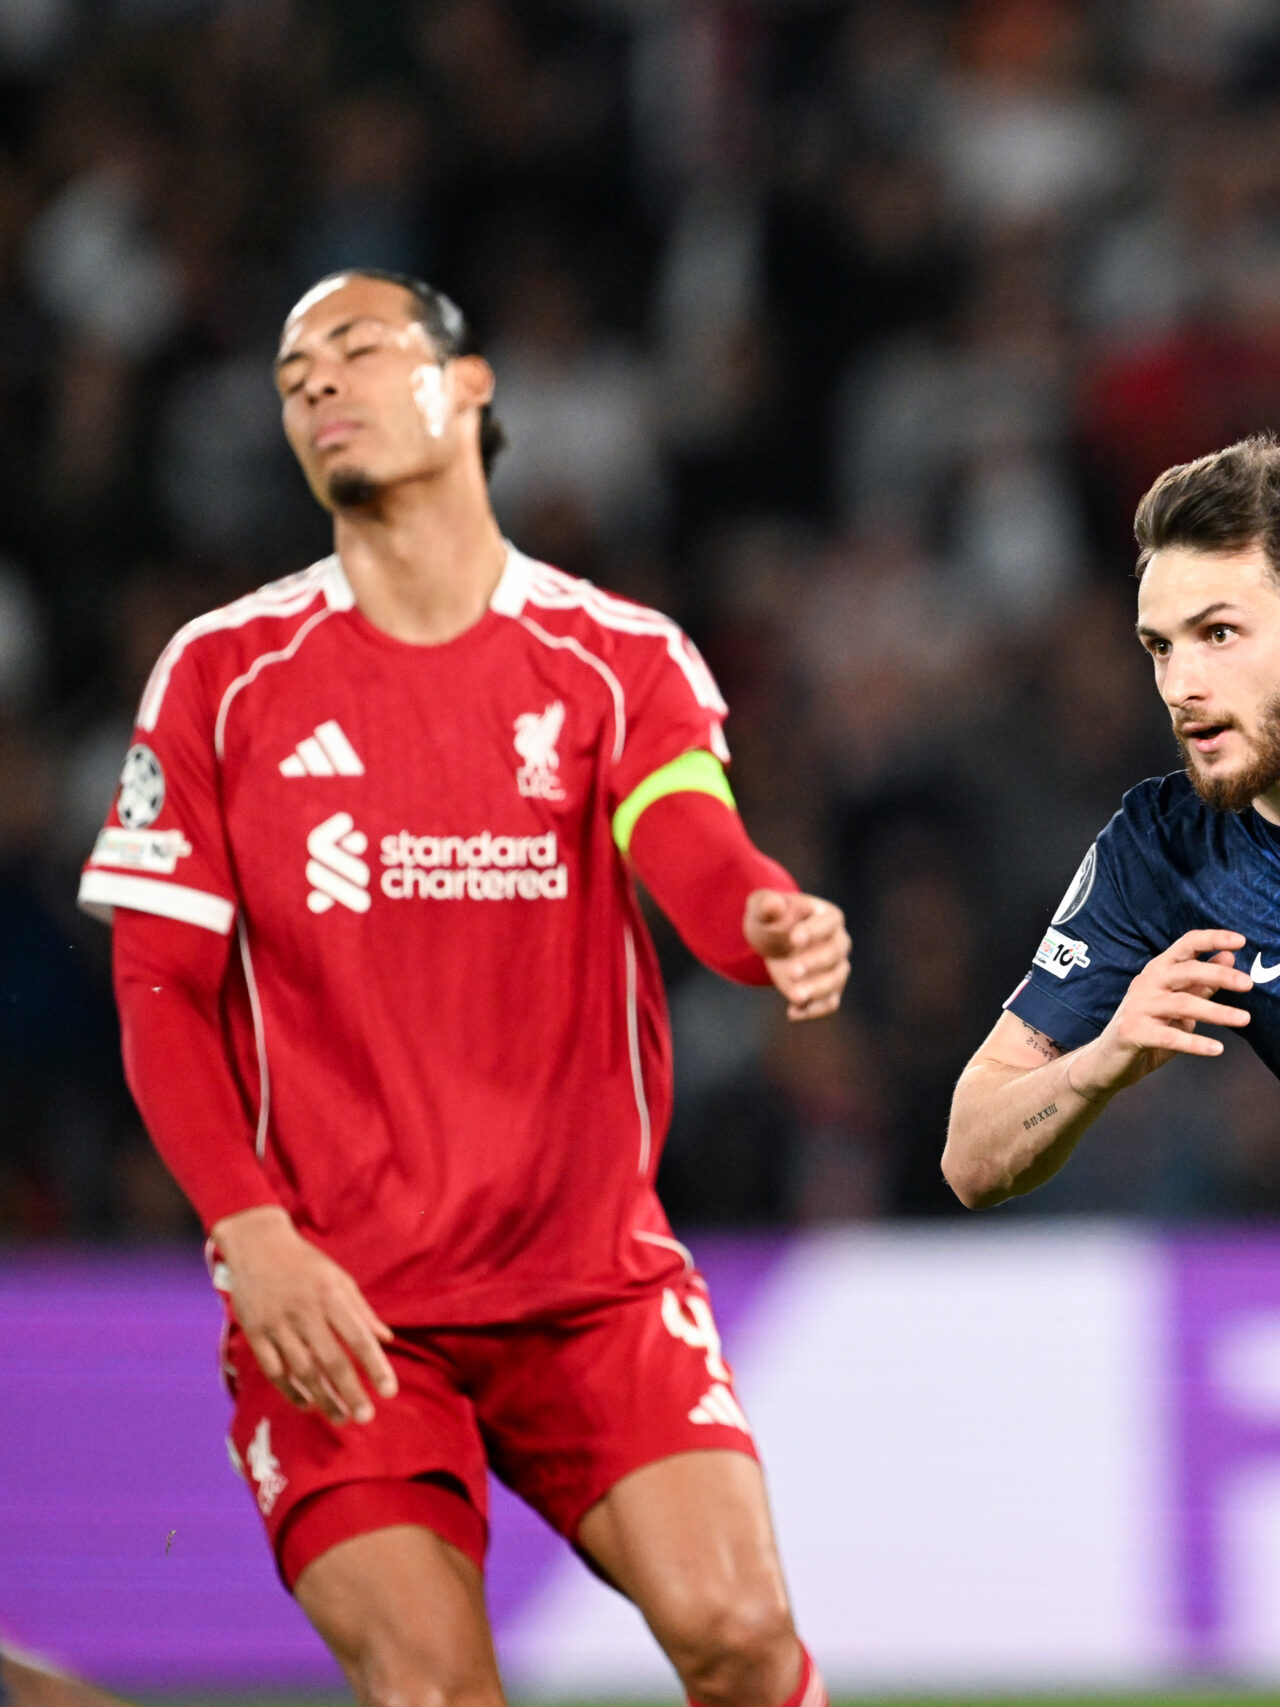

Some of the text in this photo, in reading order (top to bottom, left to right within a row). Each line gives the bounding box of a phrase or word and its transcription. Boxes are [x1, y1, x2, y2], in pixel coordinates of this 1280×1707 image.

[379, 829, 558, 868] standard
[379, 862, 568, 901] chartered
[1052, 943, 1075, 967] 10
[660, 1286, 734, 1385] 4
